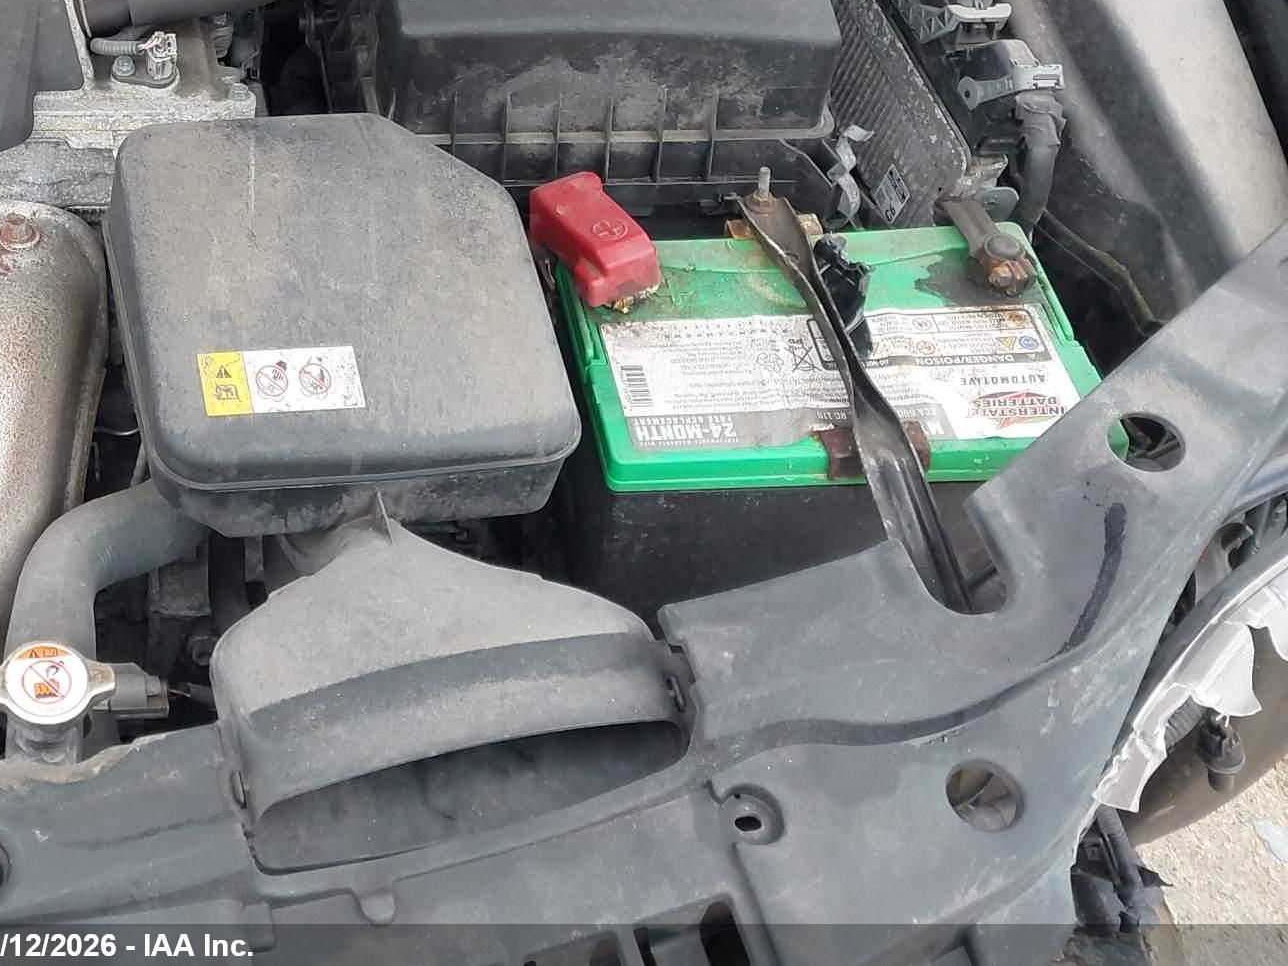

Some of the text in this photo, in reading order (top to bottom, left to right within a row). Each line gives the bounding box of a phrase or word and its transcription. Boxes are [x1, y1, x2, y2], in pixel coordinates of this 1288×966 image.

[916, 355, 1014, 366] DANGER/POISON
[961, 374, 1047, 386] AUTOMOTIVE
[972, 396, 1057, 408] BATTERIES
[969, 406, 1066, 416] INTERSTATE
[637, 422, 736, 441] 24-MONTH
